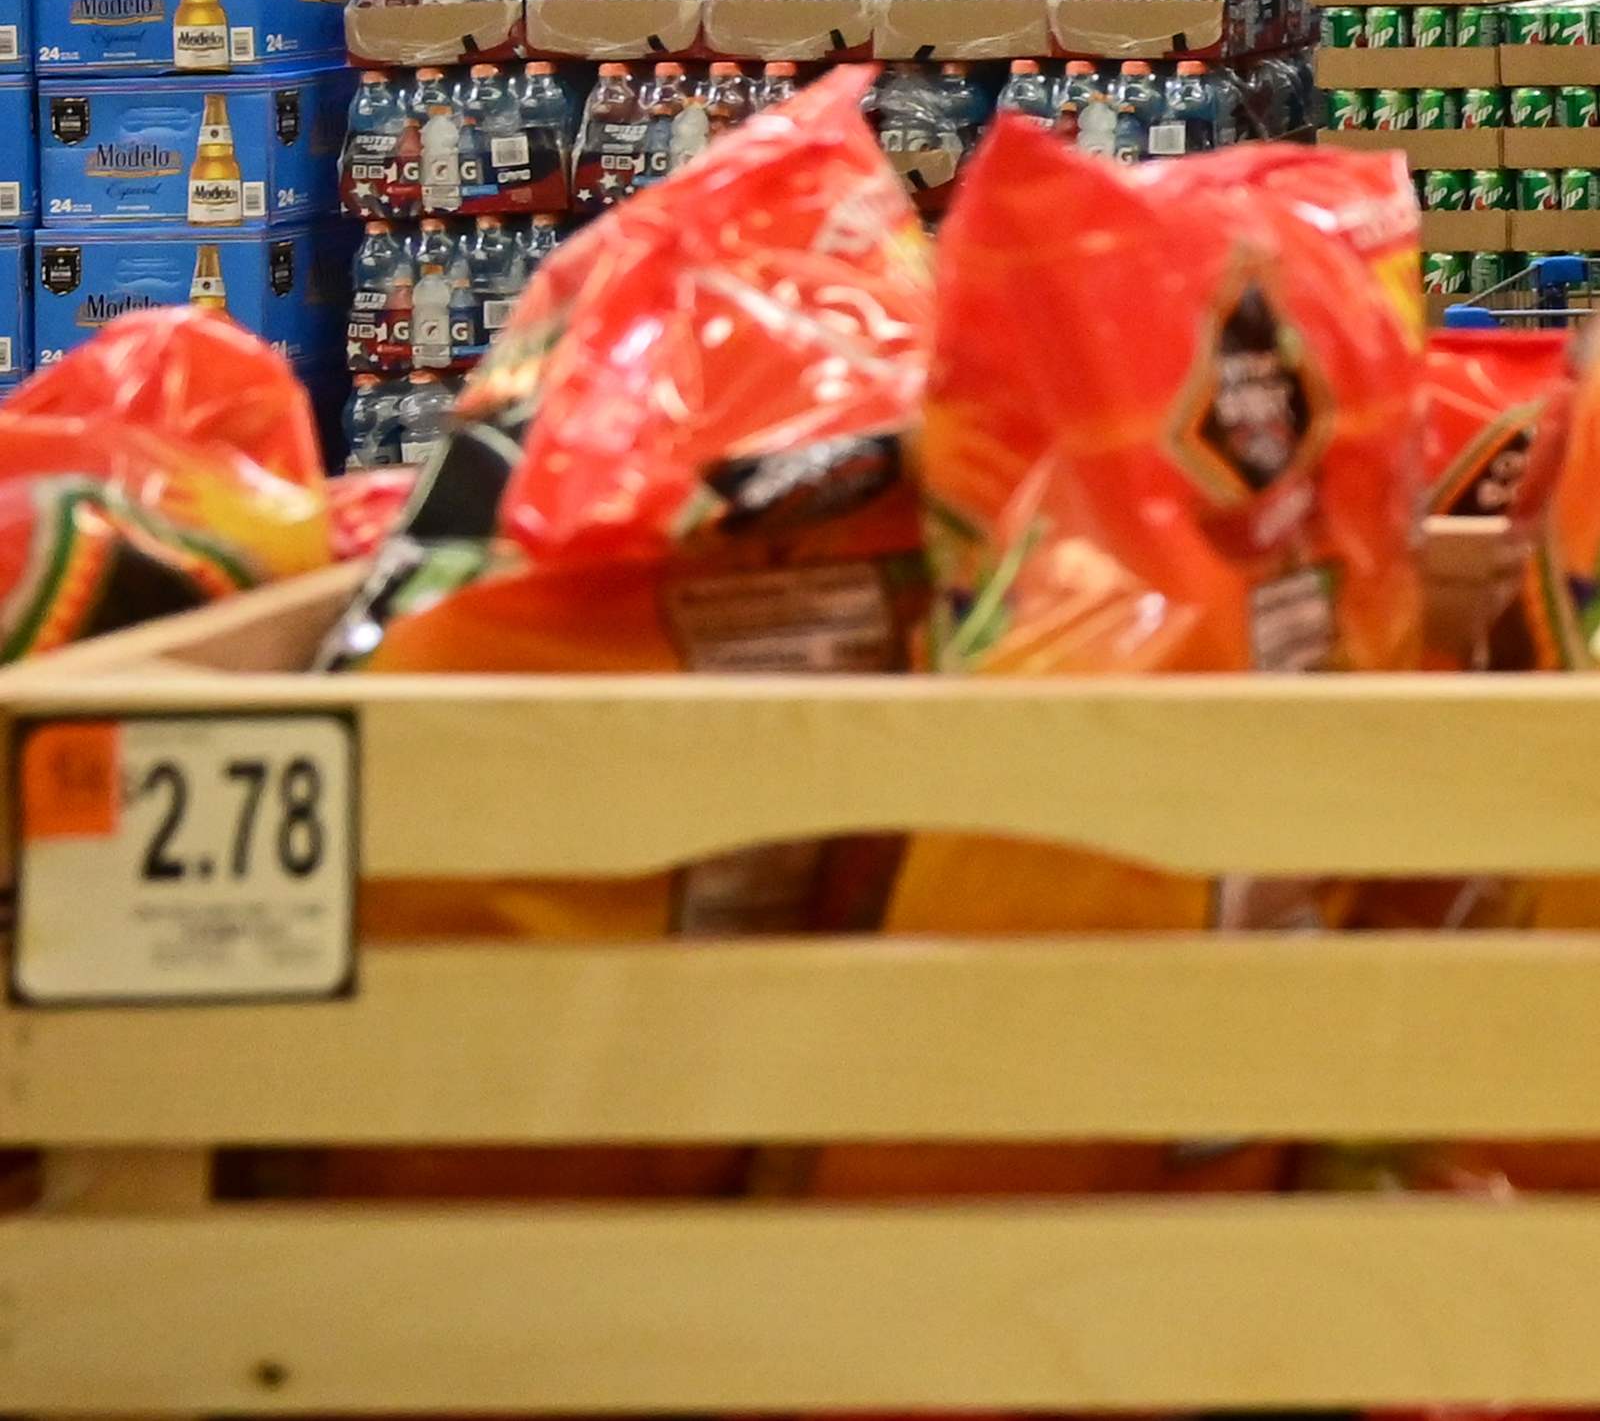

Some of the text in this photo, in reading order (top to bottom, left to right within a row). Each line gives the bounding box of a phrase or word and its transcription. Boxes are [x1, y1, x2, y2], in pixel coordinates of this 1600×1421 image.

[178, 31, 224, 47] Modelo
[266, 33, 283, 52] 24
[39, 47, 61, 62] 24
[97, 143, 170, 168] Modelo
[651, 152, 668, 172] G
[402, 161, 420, 182] G
[460, 160, 478, 181] G
[194, 186, 237, 200] Modelo
[277, 189, 295, 207] 24
[50, 199, 73, 213] 24
[393, 322, 410, 341] G
[452, 322, 469, 341] G
